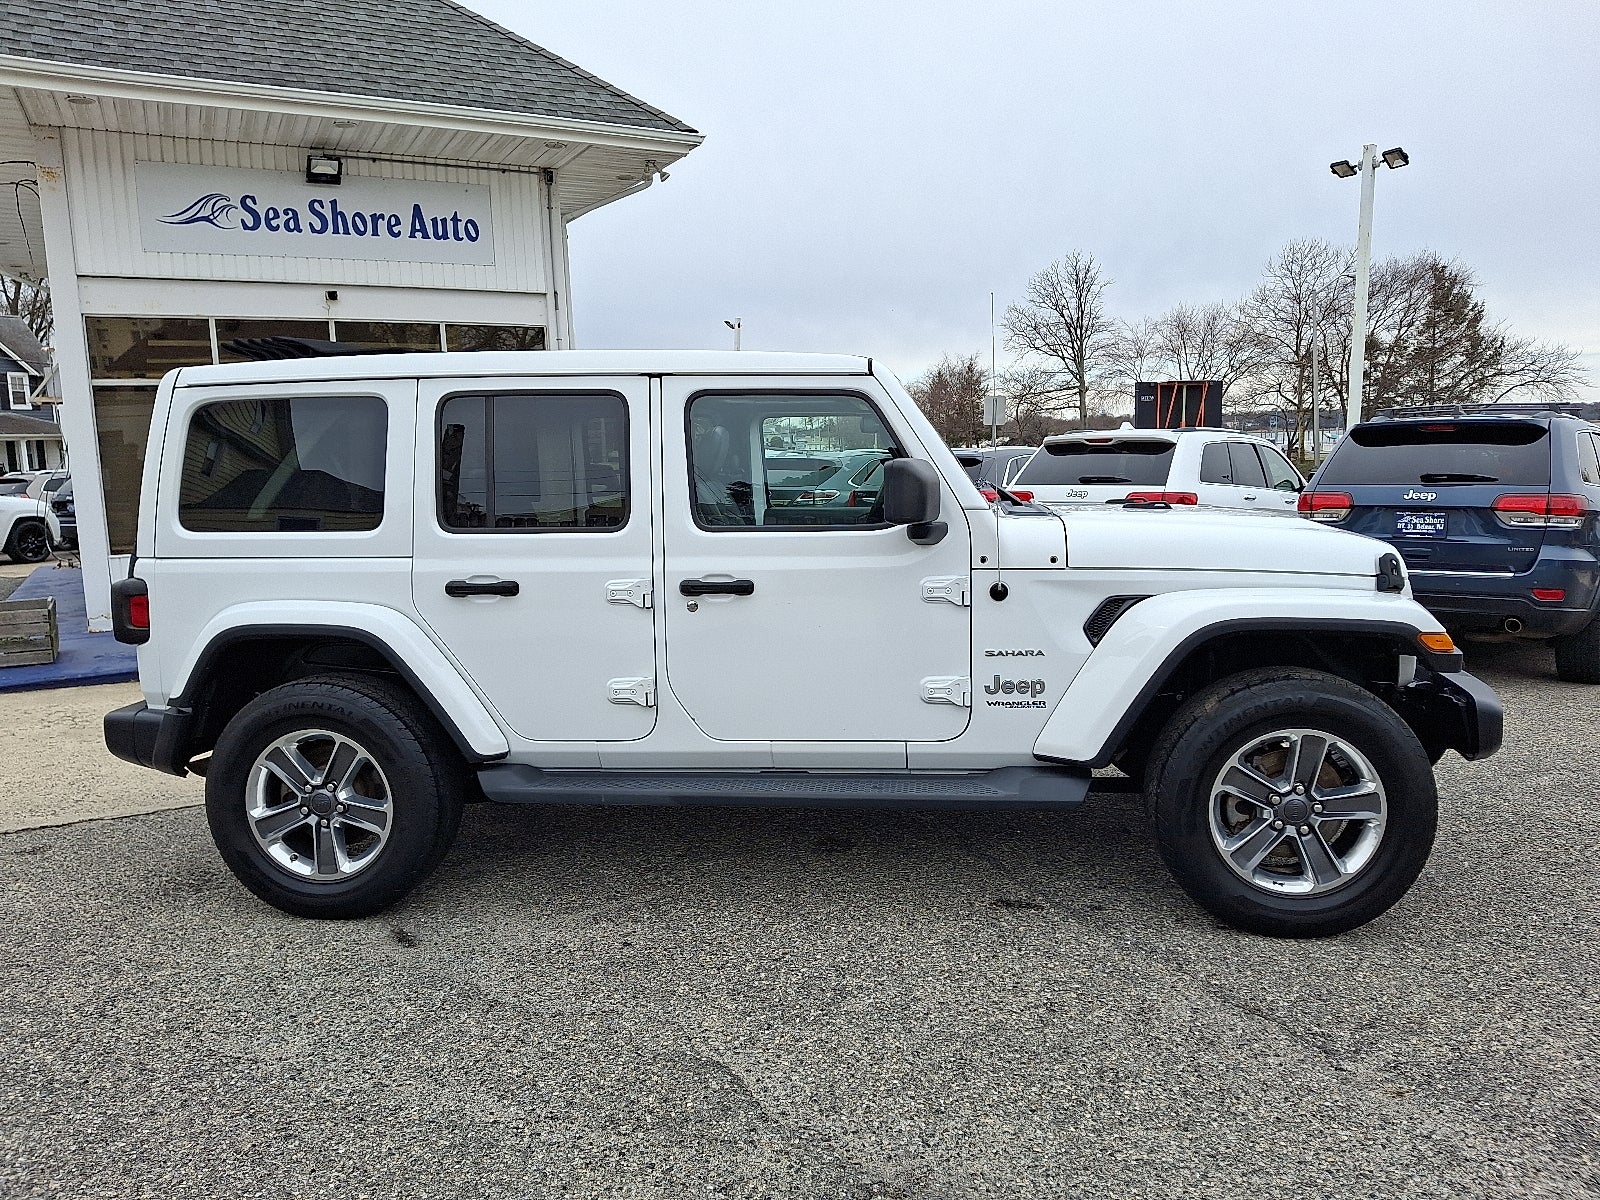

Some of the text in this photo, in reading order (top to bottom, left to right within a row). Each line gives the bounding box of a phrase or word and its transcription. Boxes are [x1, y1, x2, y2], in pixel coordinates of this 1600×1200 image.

[239, 194, 480, 243] Sea Shore Auto
[1066, 488, 1089, 500] Jeep
[1403, 489, 1437, 502] Jeep
[1411, 515, 1445, 524] Sea Shore
[984, 649, 1046, 657] SAHARA
[984, 674, 1046, 699] Jeep
